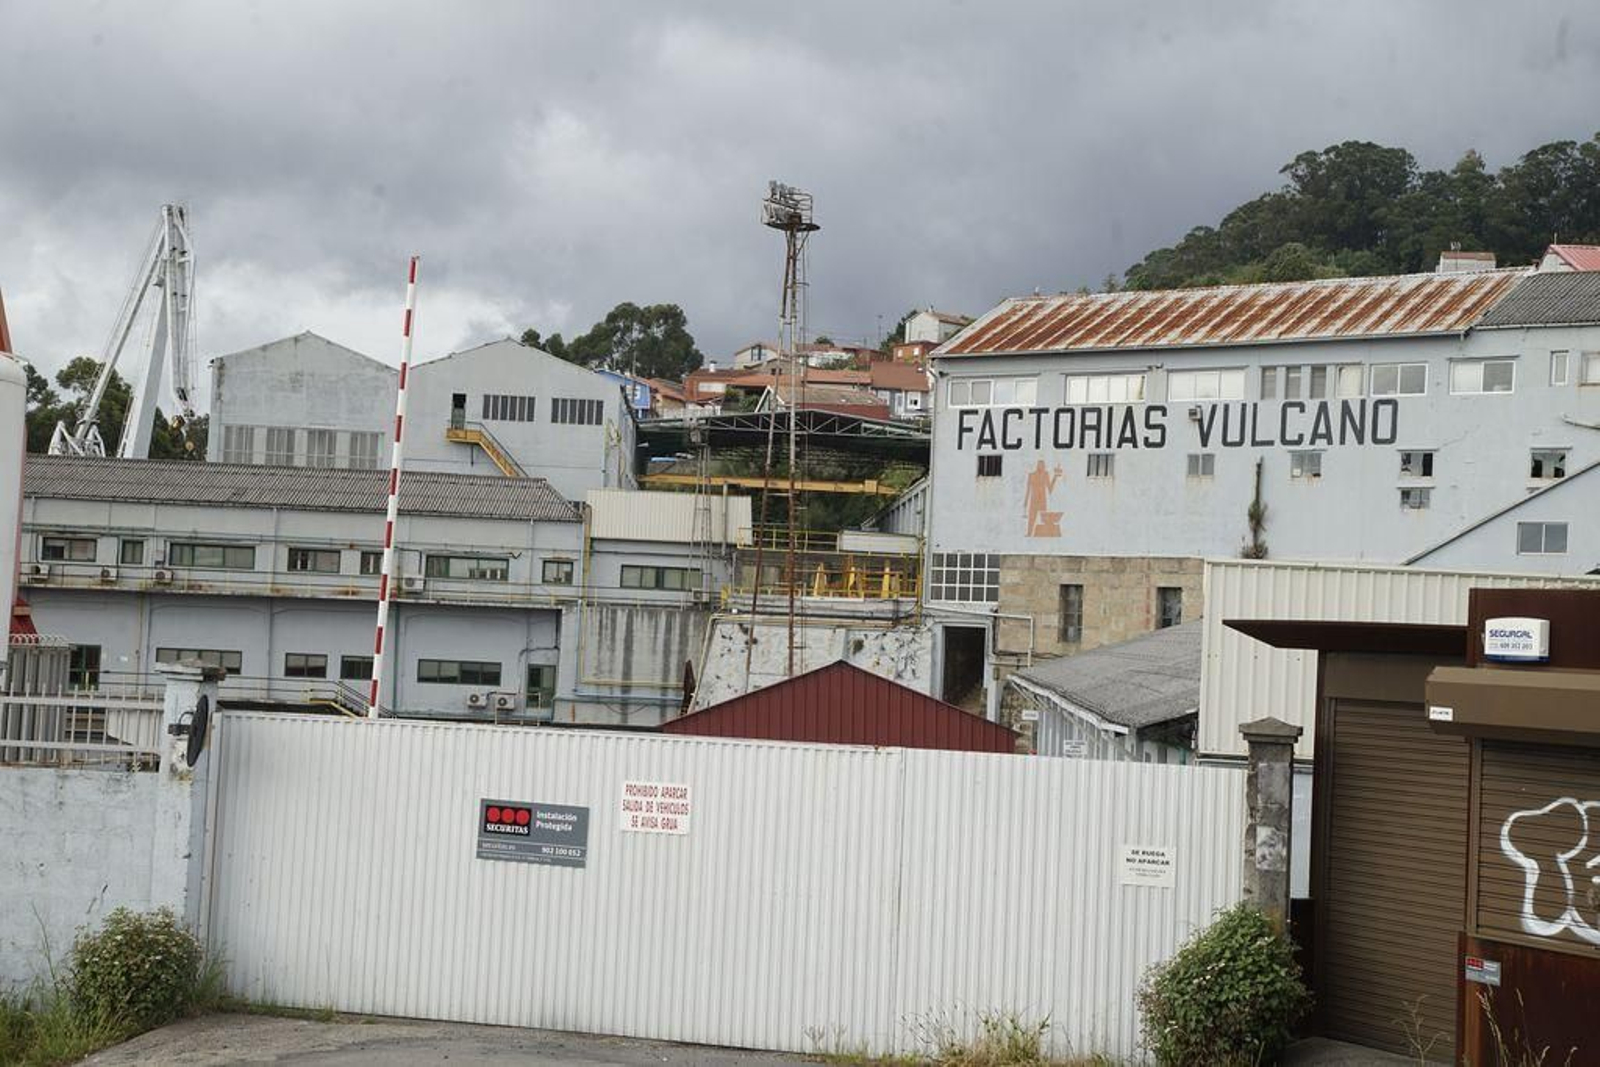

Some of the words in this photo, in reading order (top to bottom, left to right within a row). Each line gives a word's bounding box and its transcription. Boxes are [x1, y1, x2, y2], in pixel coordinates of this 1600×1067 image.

[957, 404, 1168, 450] FACTORIAS
[1198, 399, 1399, 448] VULCANO
[1489, 629, 1533, 639] SEGURGAL
[625, 783, 659, 798] PROHIBIDO
[661, 786, 688, 800] APARCAR
[622, 799, 643, 812] SALIDA
[646, 801, 654, 813] DE
[656, 802, 689, 816] VEHICULOS
[536, 811, 578, 822] Instalación
[631, 815, 638, 828] SE
[641, 816, 658, 829] AVISA
[661, 817, 678, 830] GRUA
[486, 823, 529, 835] SECURITAS
[535, 820, 573, 832] Protegida
[541, 846, 554, 854] 902
[555, 847, 567, 855] 100
